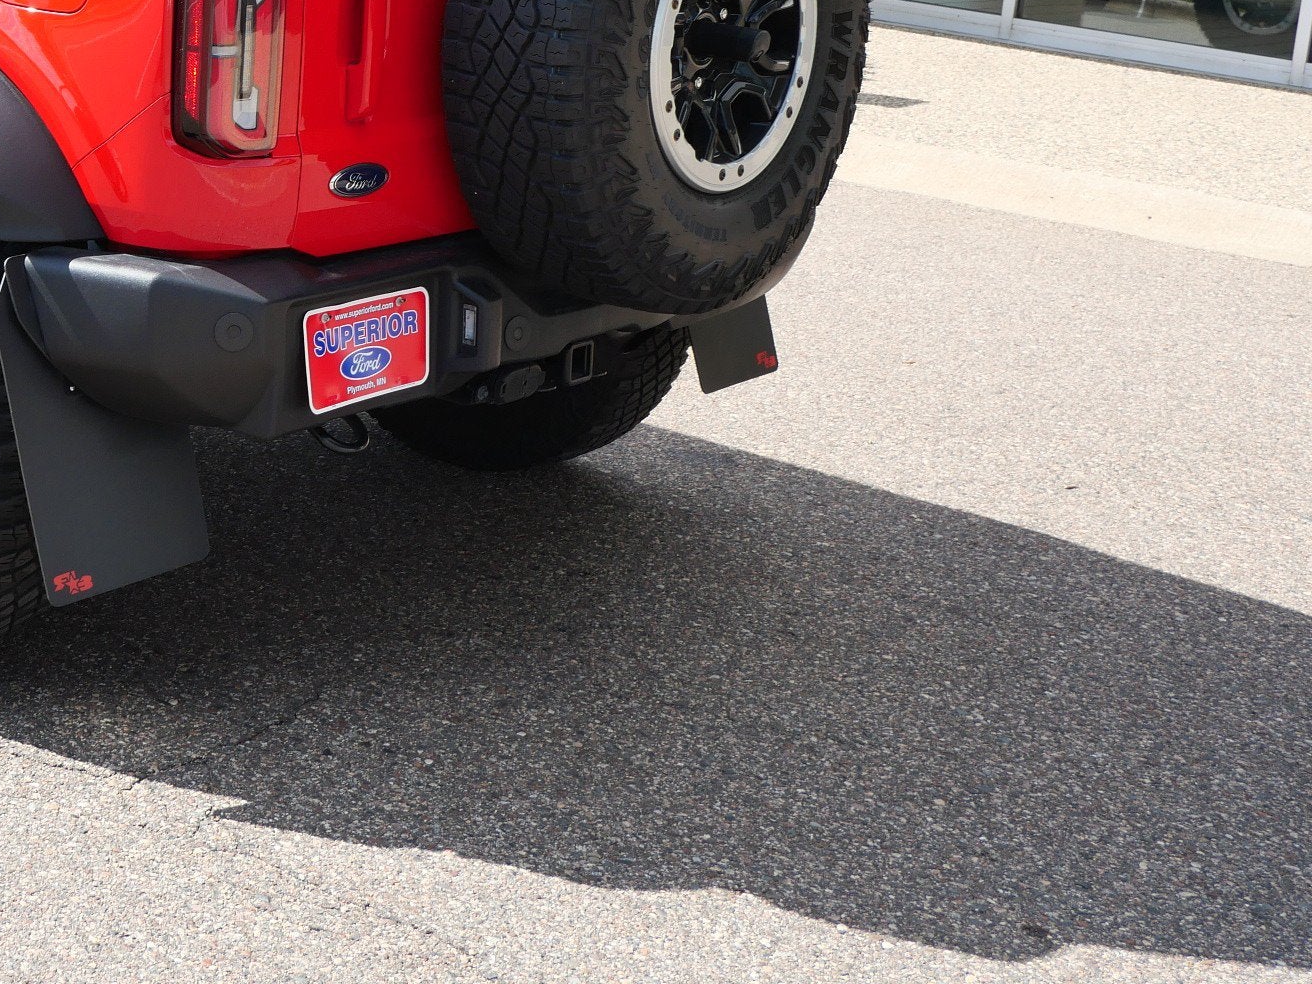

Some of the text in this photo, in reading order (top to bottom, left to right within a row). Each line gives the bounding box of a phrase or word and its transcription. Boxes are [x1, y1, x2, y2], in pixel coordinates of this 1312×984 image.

[750, 10, 854, 231] WRANGLER
[345, 172, 378, 192] Ford
[334, 301, 395, 321] www.superiorford.com
[313, 309, 419, 358] SUPERIOR
[350, 351, 381, 376] Ford
[346, 377, 386, 395] Plymouth, MN
